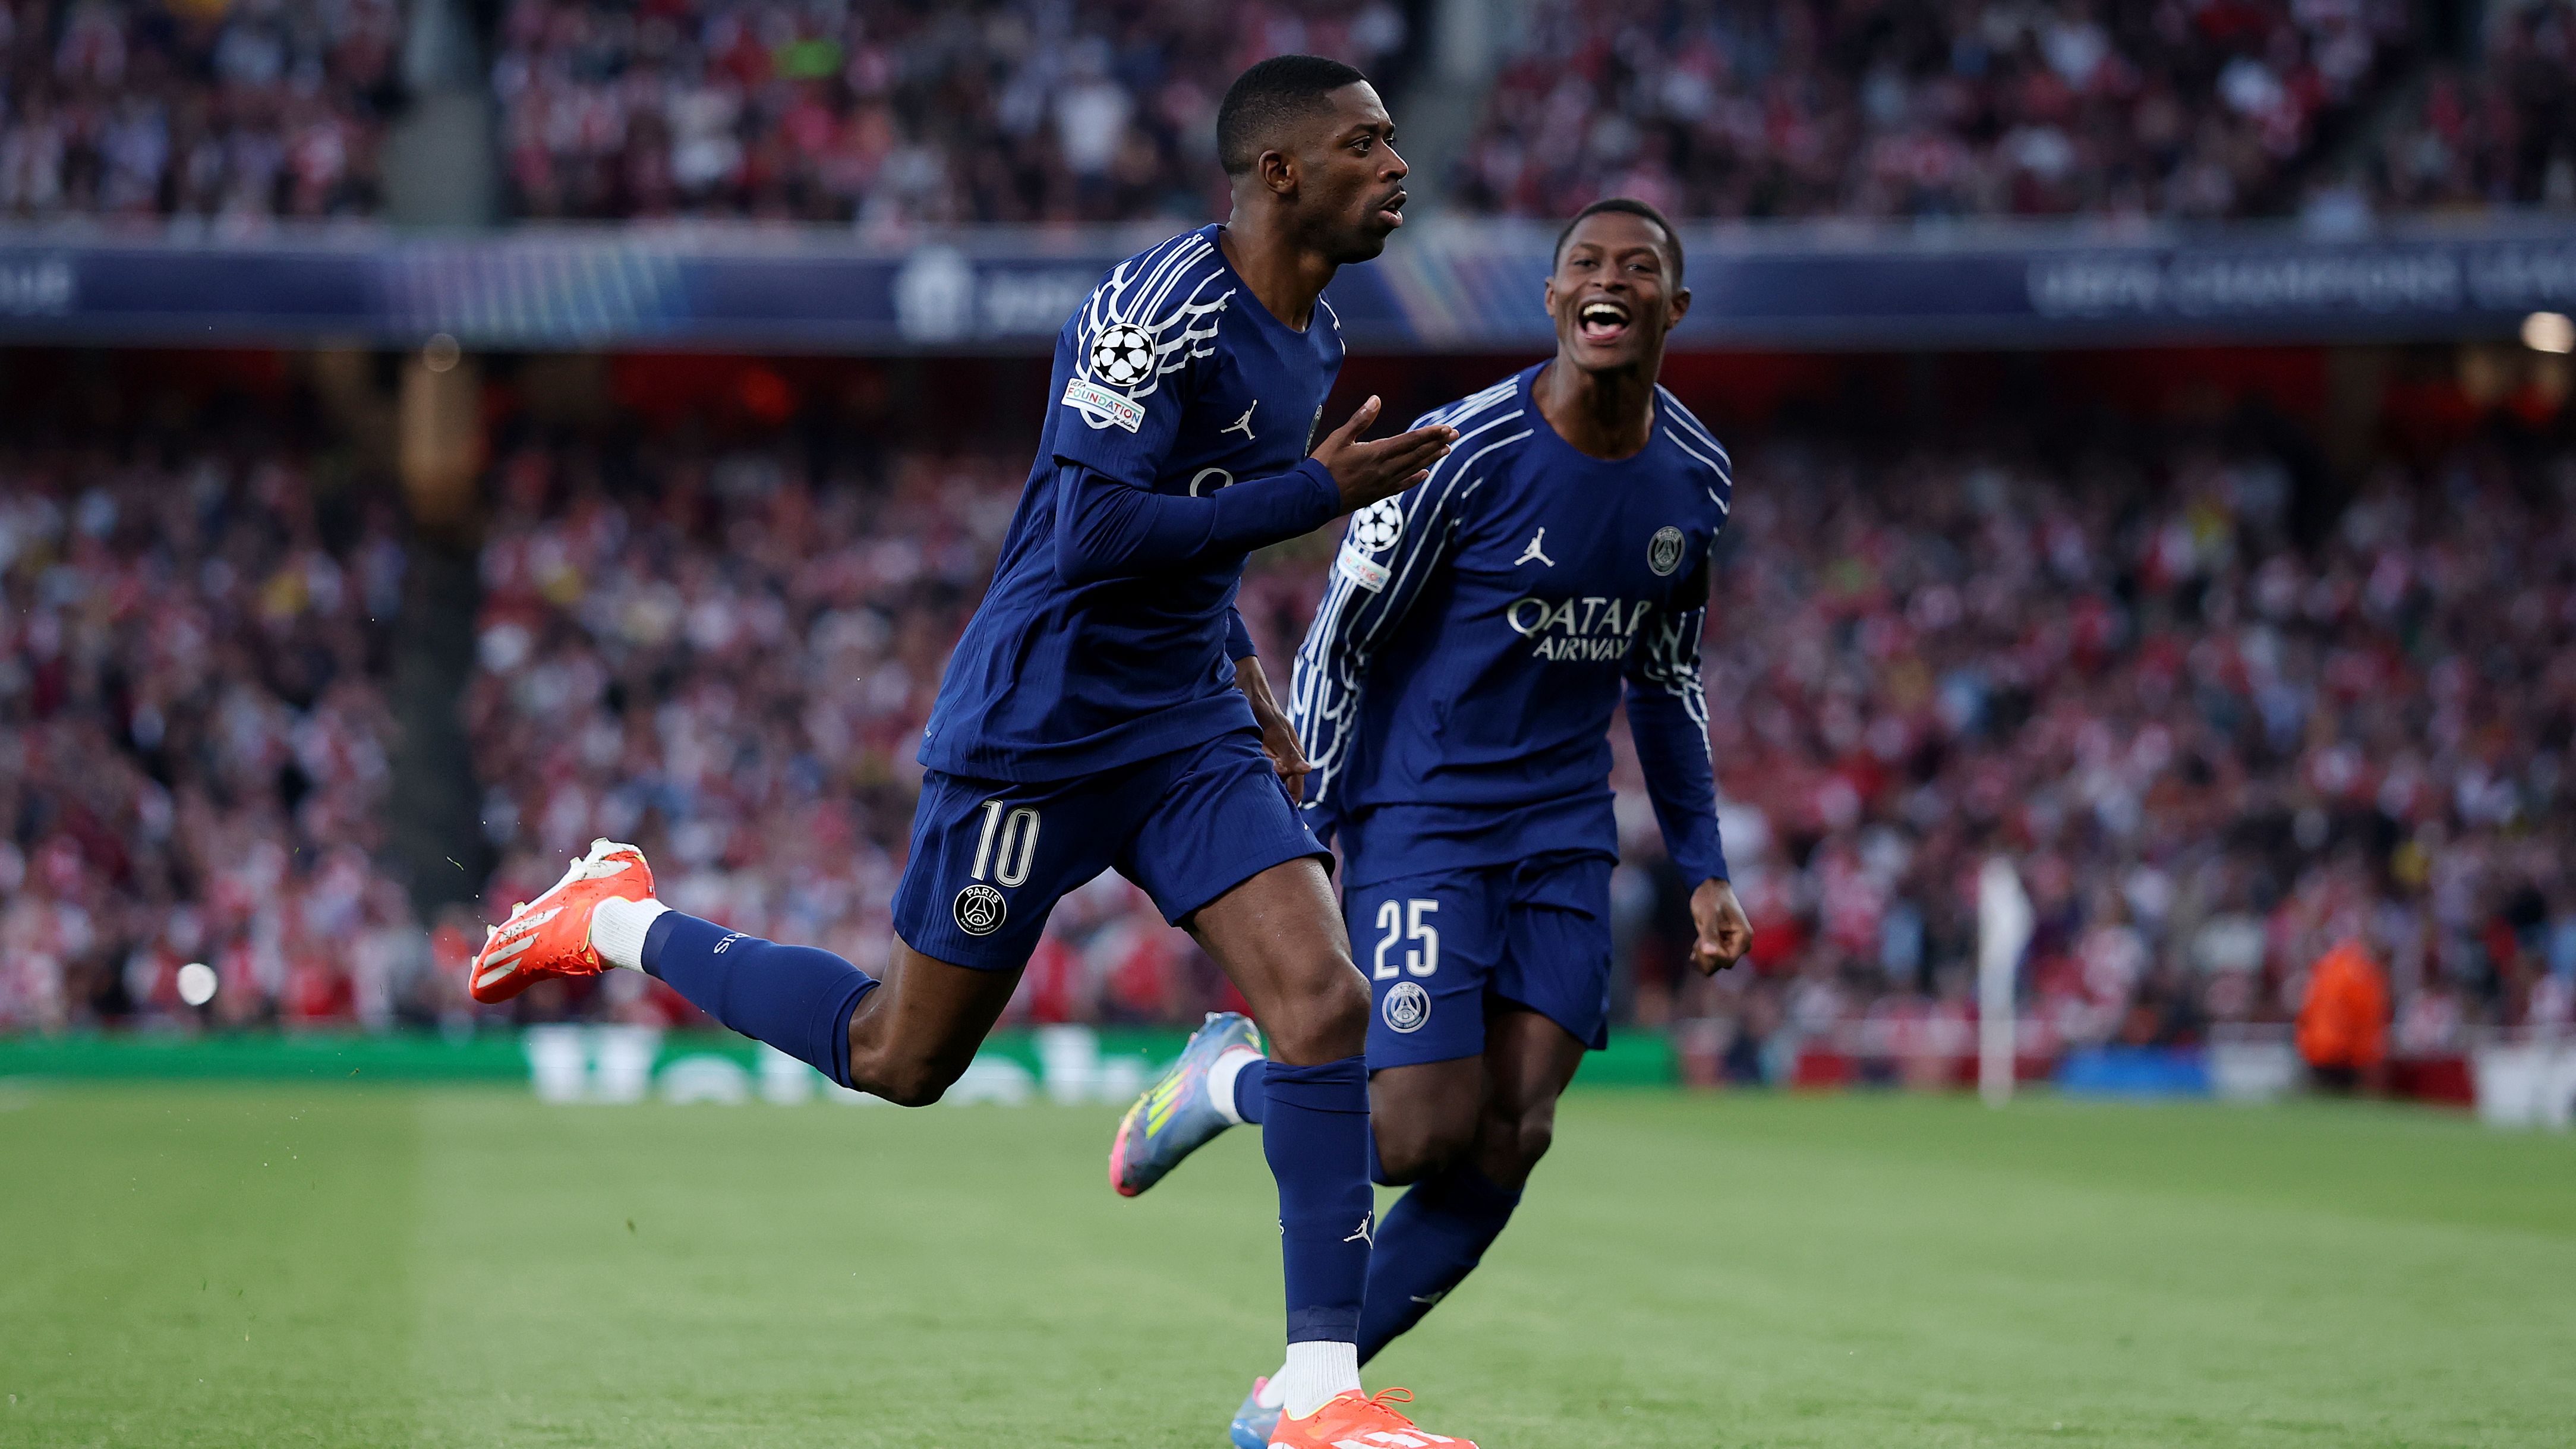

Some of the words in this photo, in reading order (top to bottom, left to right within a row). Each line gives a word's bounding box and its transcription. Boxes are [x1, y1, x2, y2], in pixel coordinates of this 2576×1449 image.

[1067, 388, 1140, 424] FOUNDATION
[971, 798, 1041, 888] 10
[966, 887, 1000, 903] PARIS
[1373, 898, 1439, 981] 25
